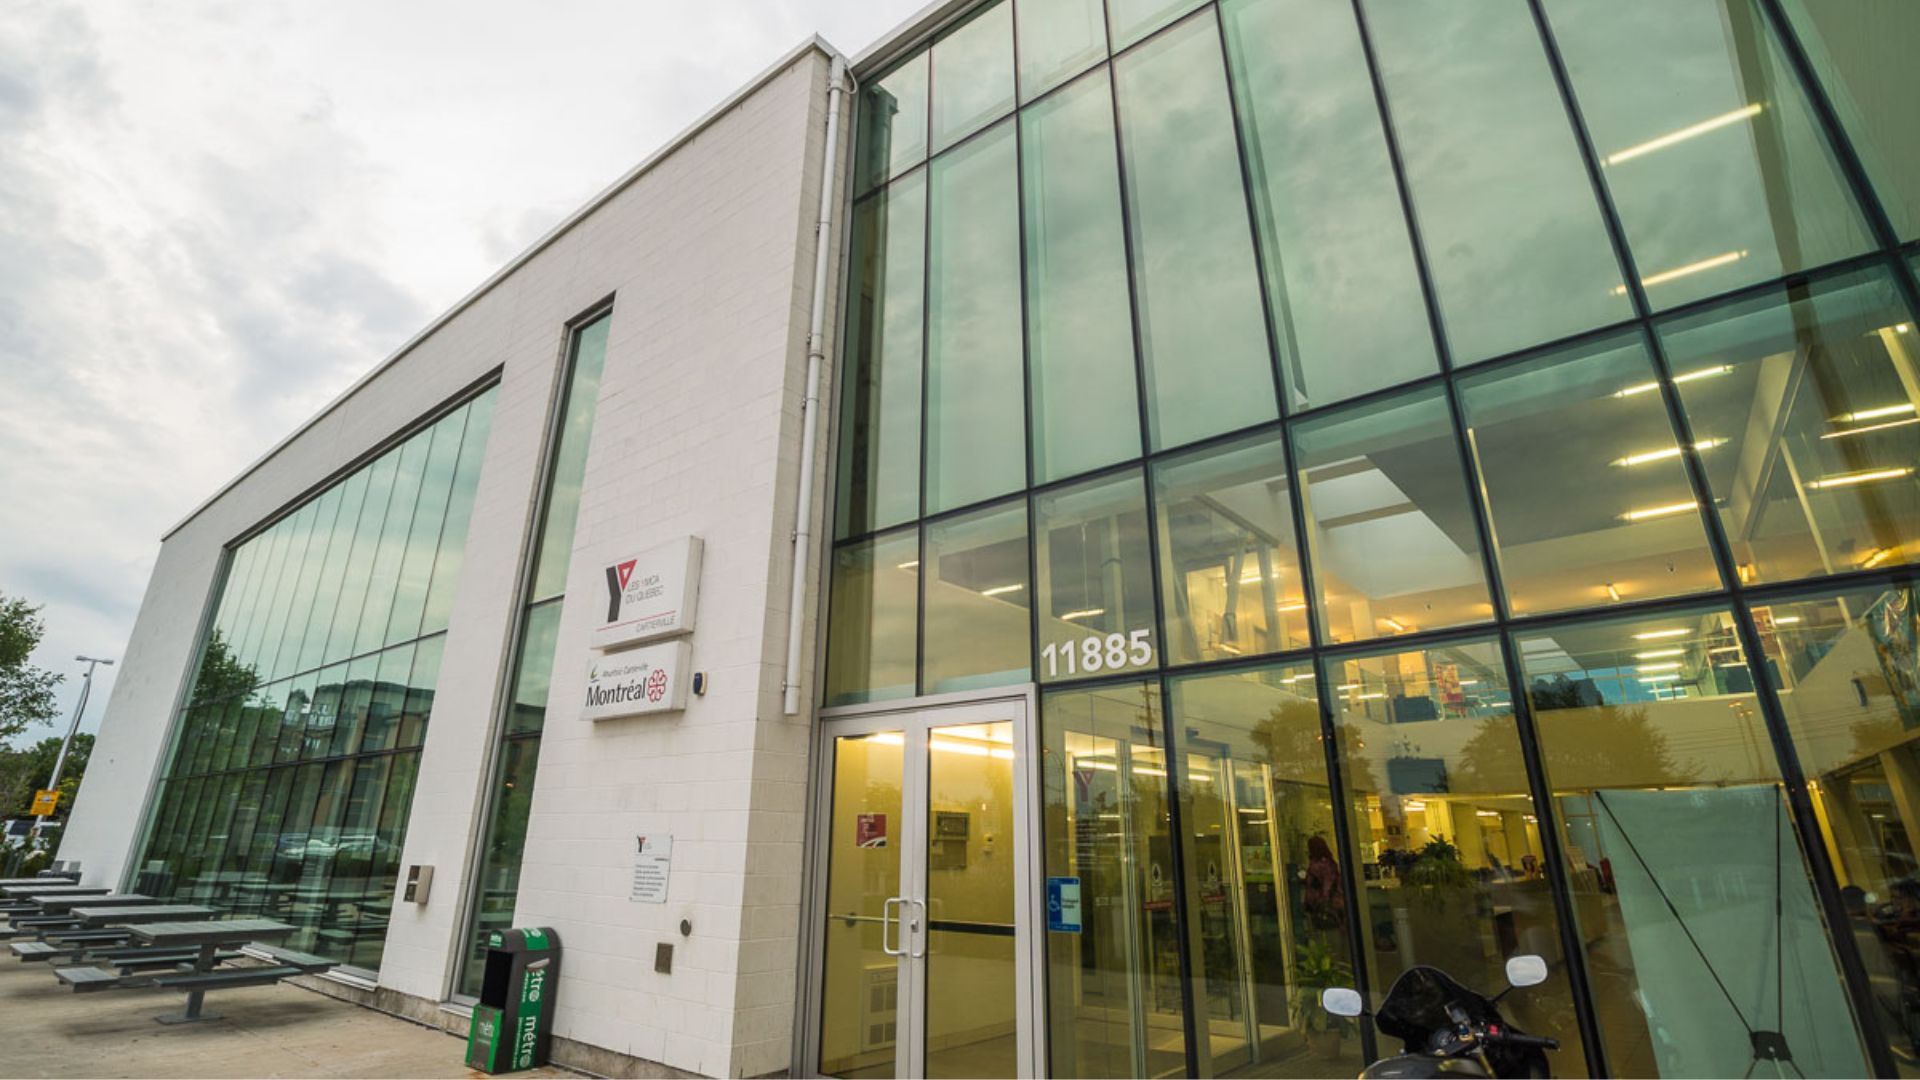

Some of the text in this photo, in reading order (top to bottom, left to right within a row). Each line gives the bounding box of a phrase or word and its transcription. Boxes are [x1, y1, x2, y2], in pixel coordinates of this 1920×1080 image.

[625, 594, 636, 605] DU
[1041, 628, 1152, 697] 11885
[585, 677, 647, 707] Montréal
[519, 1016, 537, 1068] métro
